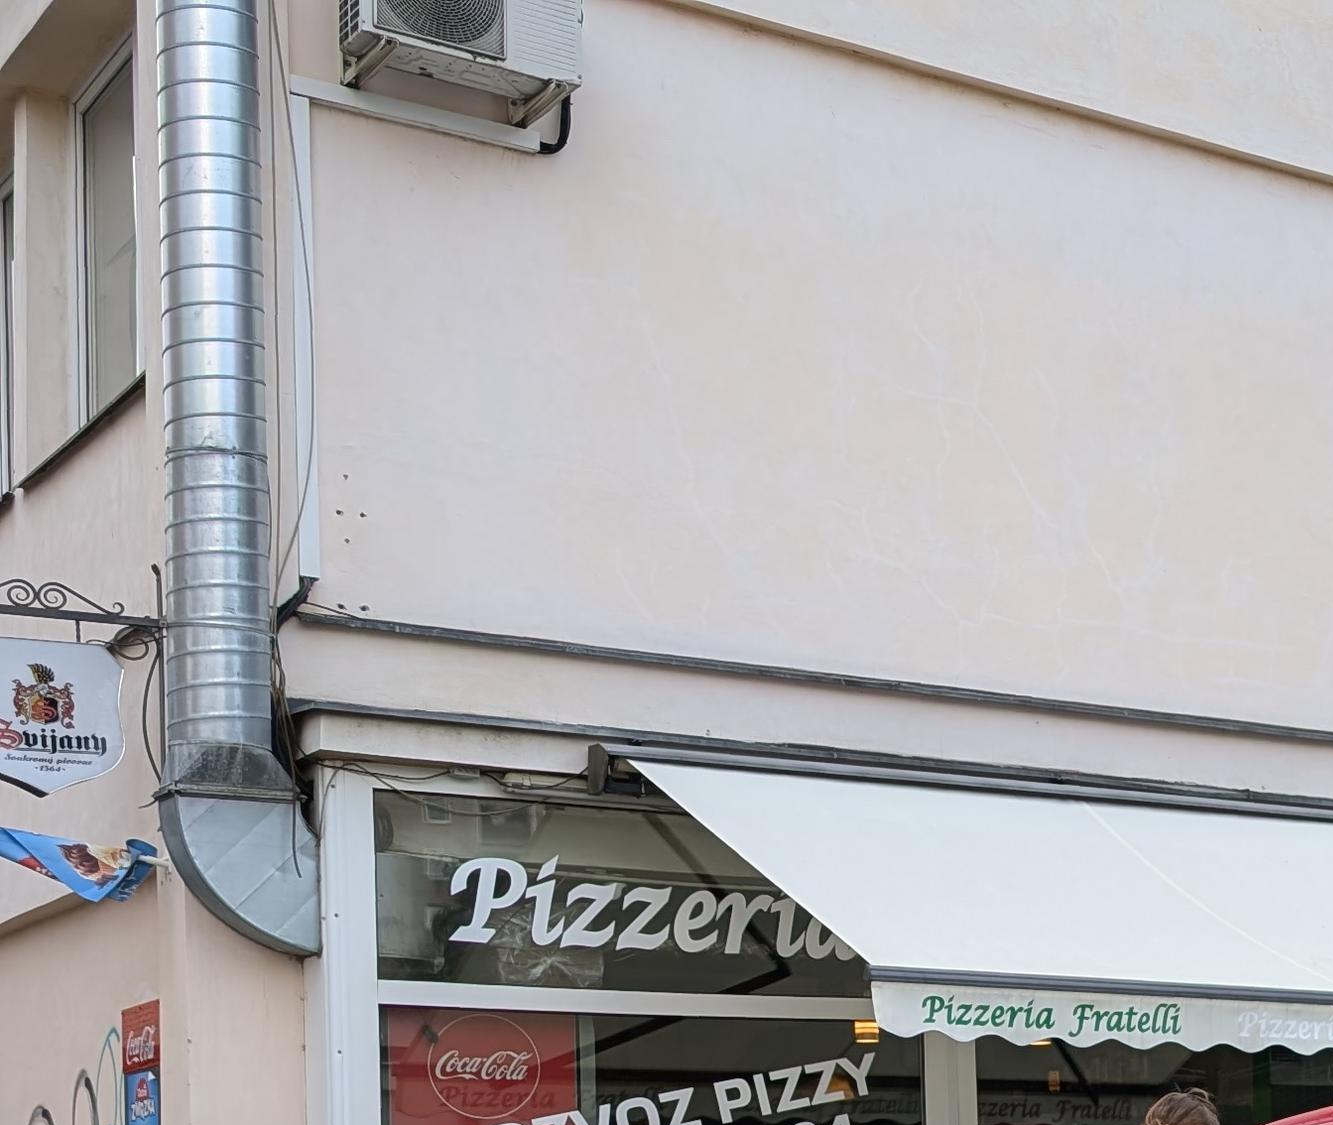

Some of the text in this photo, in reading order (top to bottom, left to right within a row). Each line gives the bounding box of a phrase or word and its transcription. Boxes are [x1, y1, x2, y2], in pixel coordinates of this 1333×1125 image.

[922, 995, 1182, 1038] Pizzeria Fratelli
[435, 1050, 533, 1082] Coca-Cola
[714, 1052, 876, 1123] PIZZY
